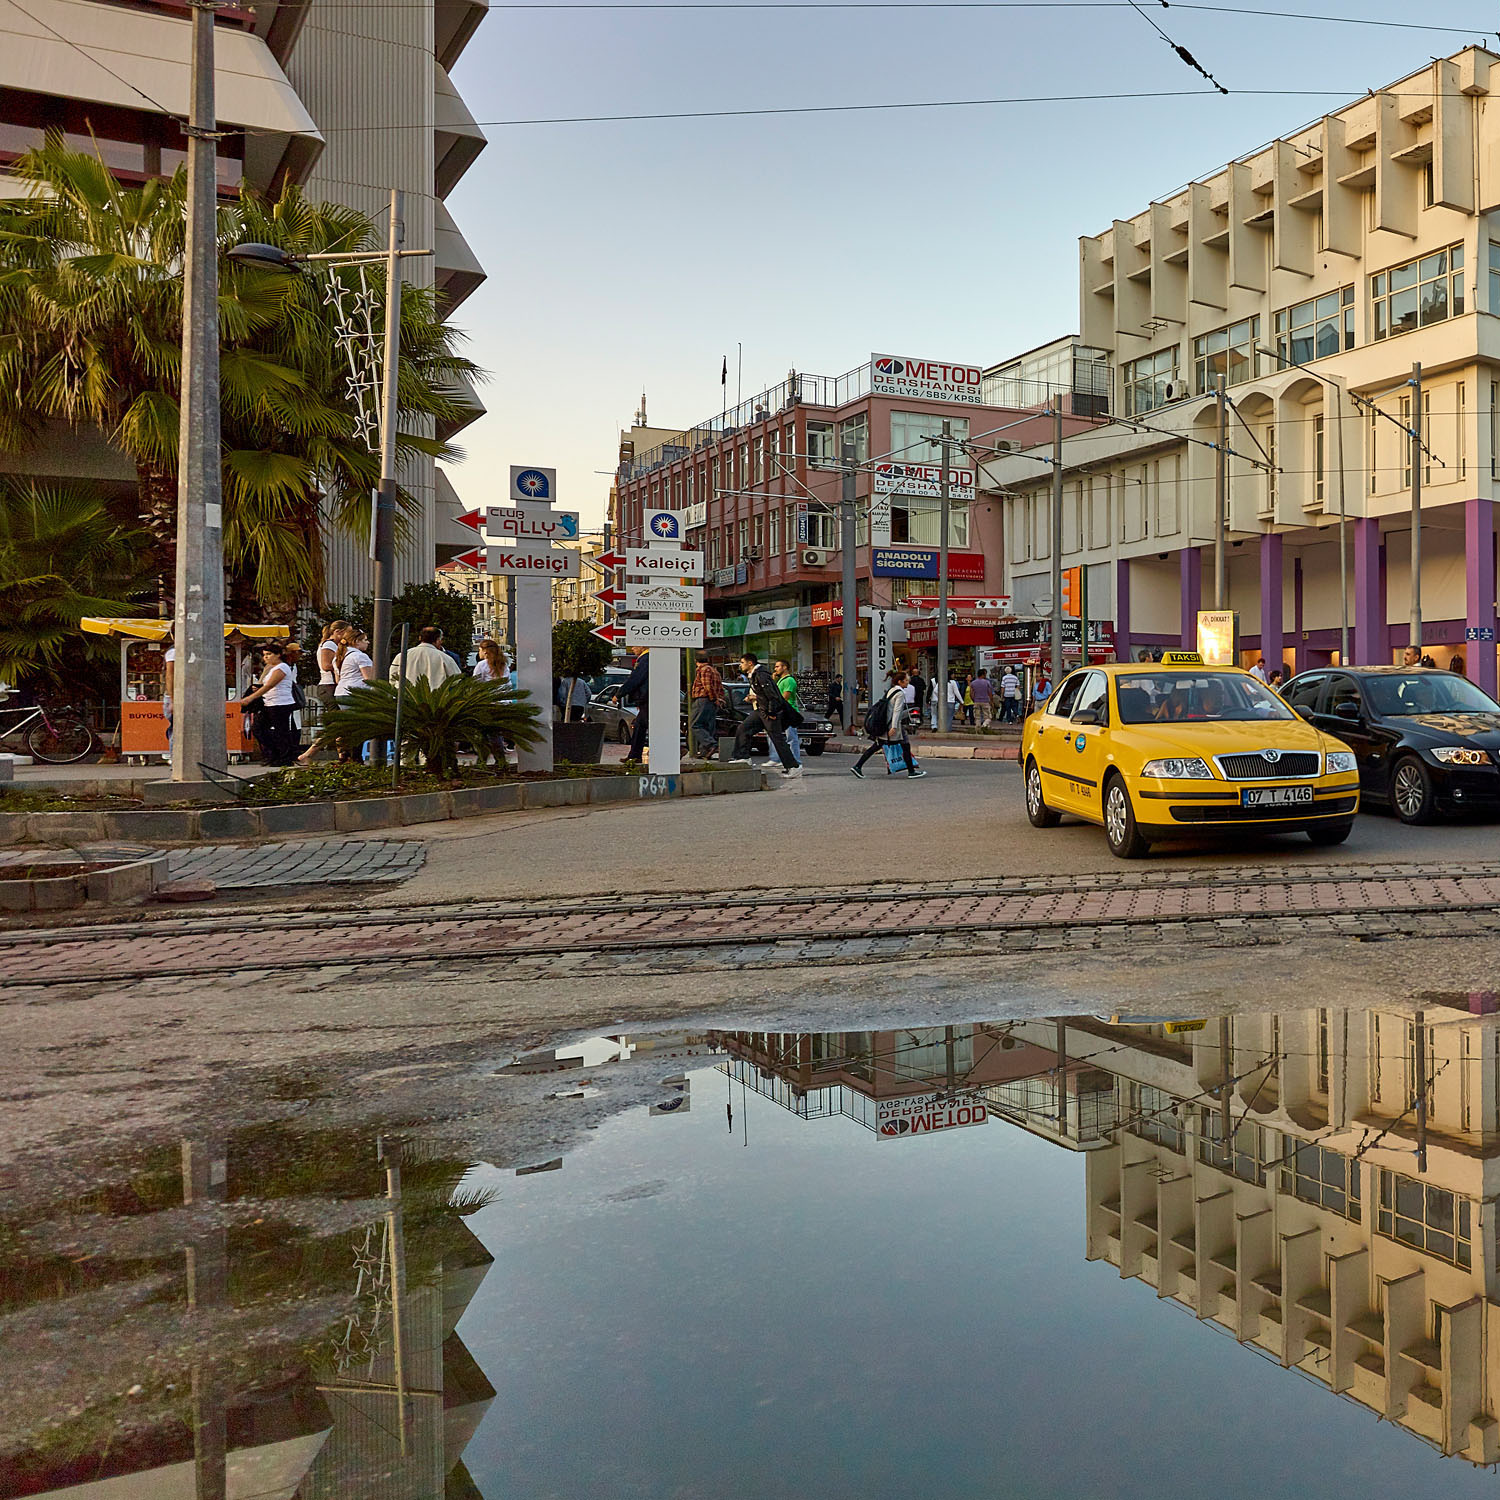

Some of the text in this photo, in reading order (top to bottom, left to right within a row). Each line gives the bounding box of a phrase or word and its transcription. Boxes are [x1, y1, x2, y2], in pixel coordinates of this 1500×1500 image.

[905, 360, 981, 386] METOD
[490, 508, 525, 519] CLUB
[500, 553, 568, 573] Kaleiçi
[876, 552, 932, 561] ANADOLU
[636, 556, 695, 573] Kaleiçi
[876, 559, 926, 569] SİGORTA
[636, 599, 668, 607] TUVANA
[813, 608, 832, 622] tiffany
[999, 628, 1029, 639] TEKNE BÜFE
[878, 611, 887, 671] YARDS
[1248, 788, 1311, 803] 07 T 4146
